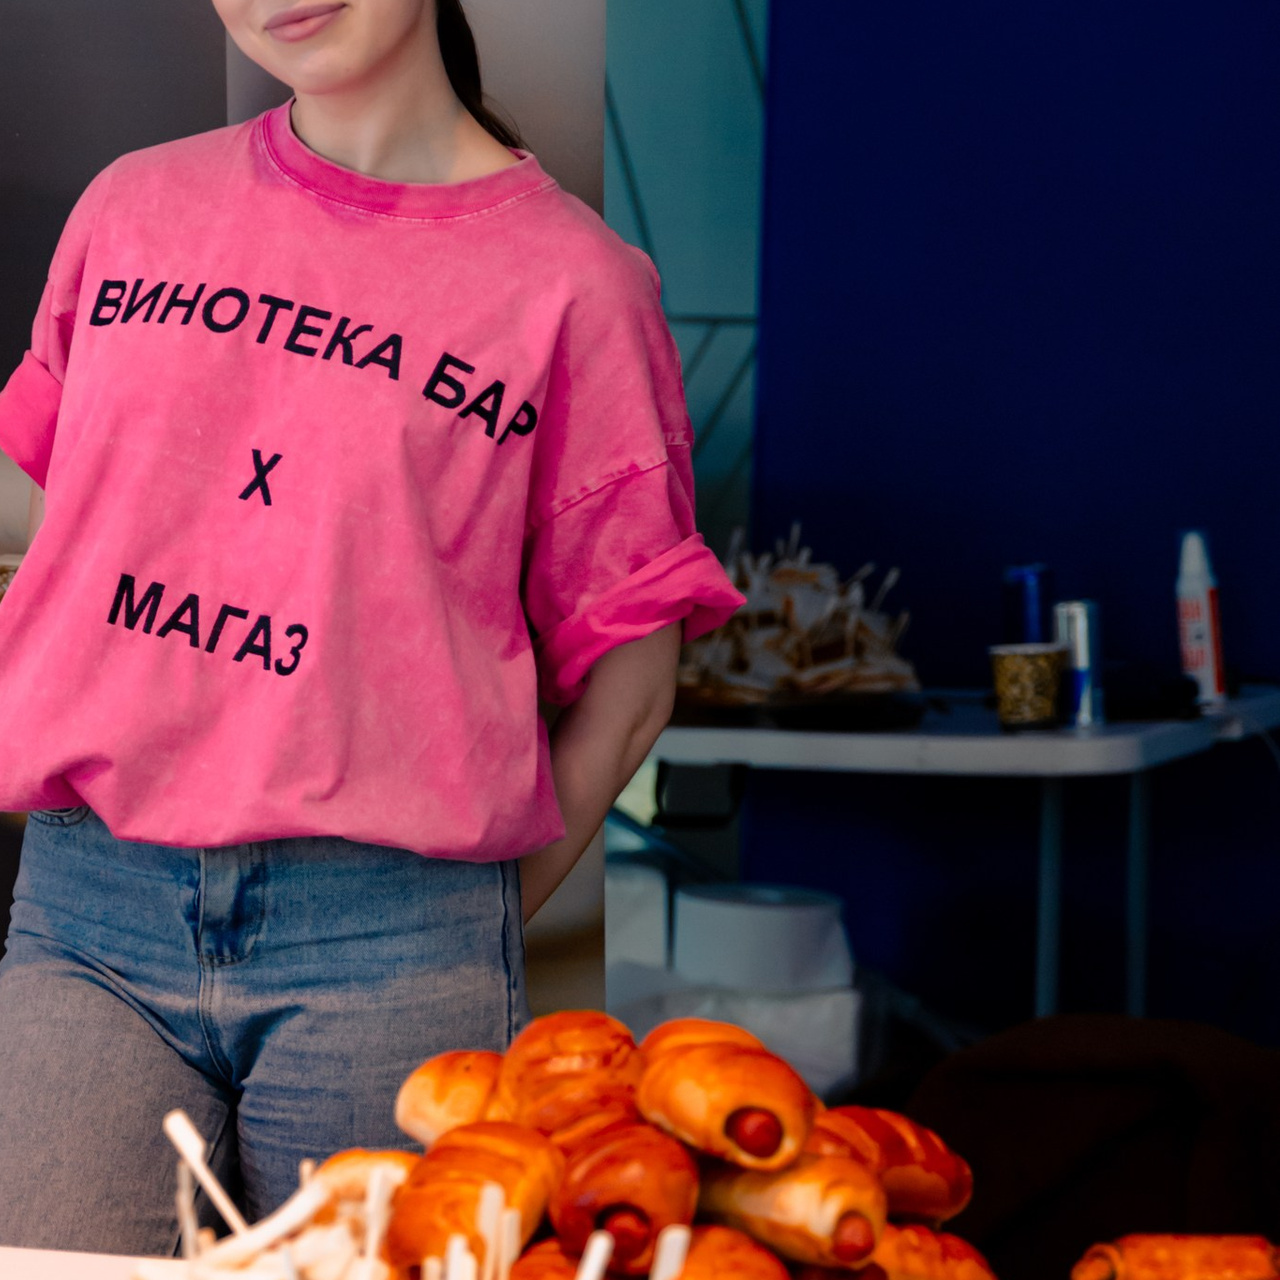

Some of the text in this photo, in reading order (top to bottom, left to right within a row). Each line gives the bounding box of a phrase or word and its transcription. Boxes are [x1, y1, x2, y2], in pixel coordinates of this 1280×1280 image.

[88, 278, 539, 446] ВИНОТЕКА БАР
[107, 572, 309, 677] МАГАЗ
